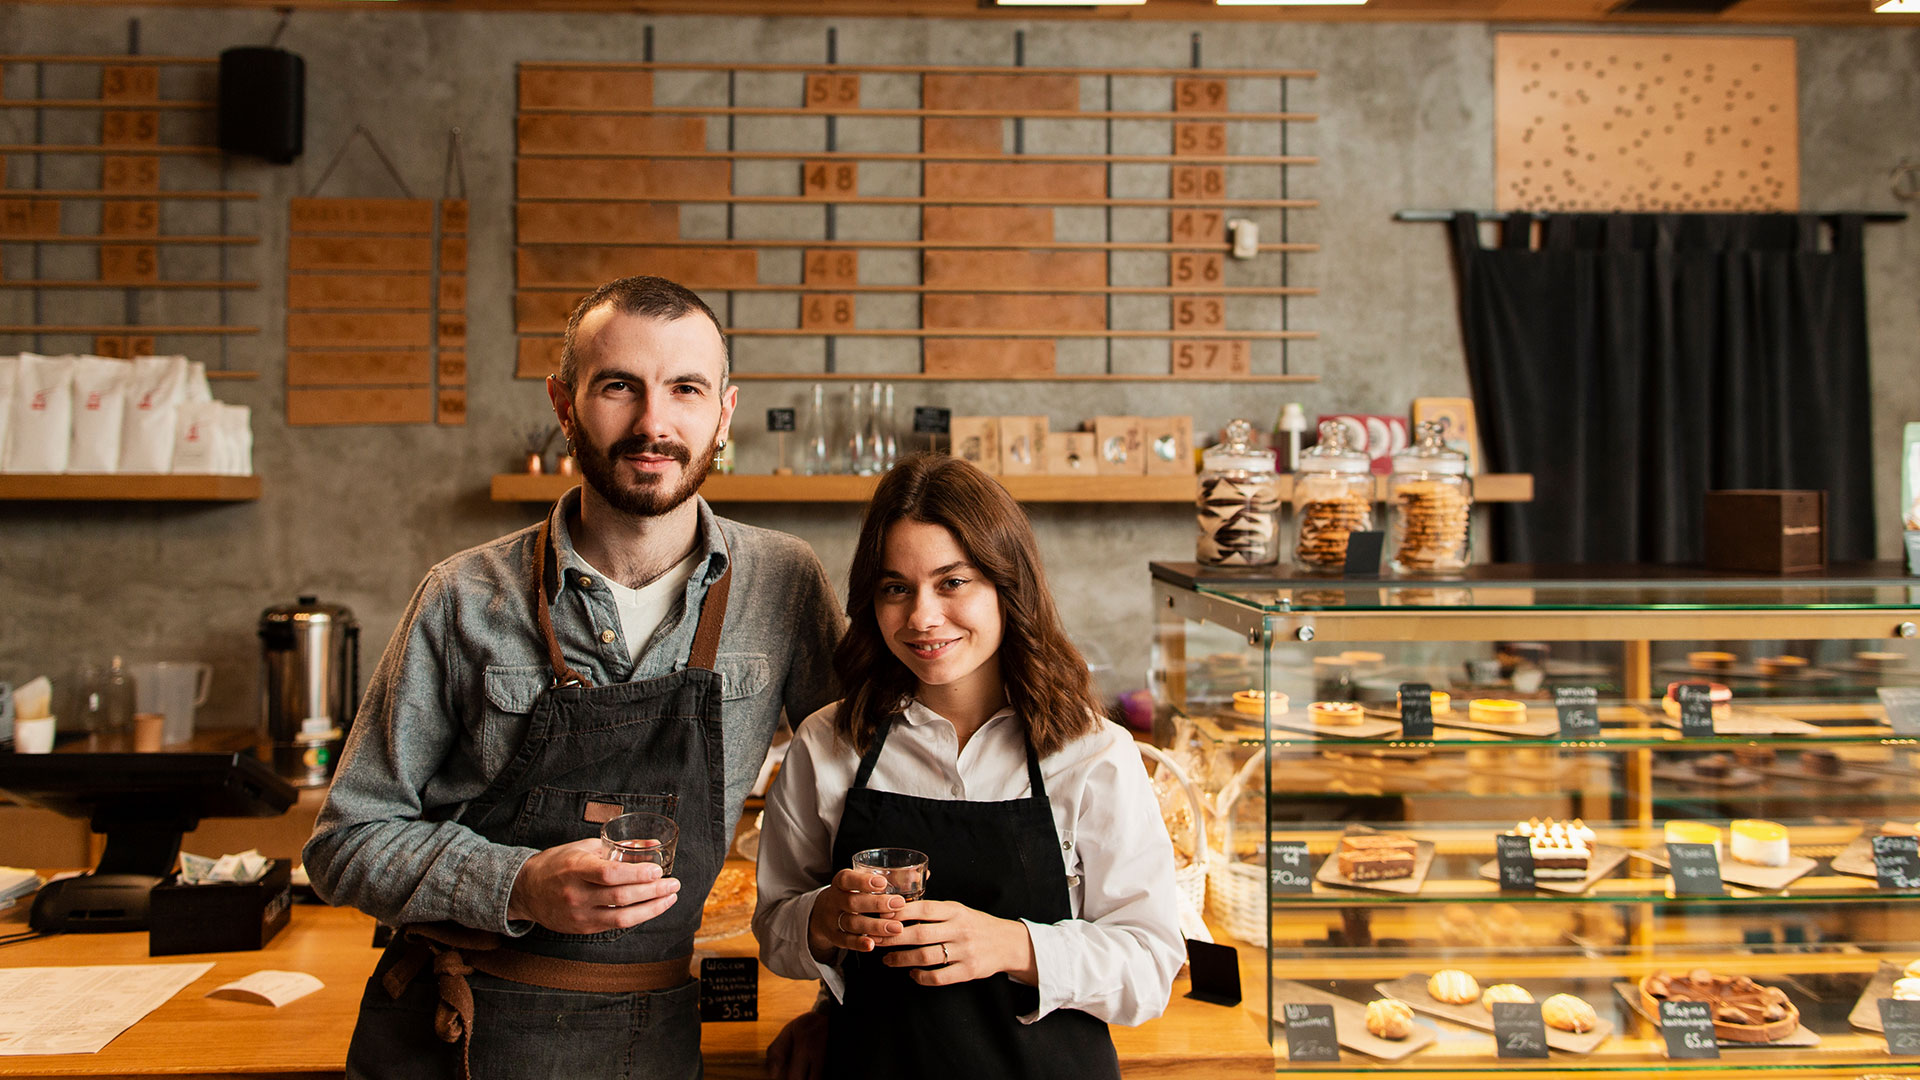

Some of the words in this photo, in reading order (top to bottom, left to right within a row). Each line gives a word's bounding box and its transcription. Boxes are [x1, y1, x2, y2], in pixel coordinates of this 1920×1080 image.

[812, 77, 854, 103] 55
[1181, 84, 1222, 107] 59
[1181, 126, 1222, 149] 55
[809, 165, 853, 191] 48
[1178, 170, 1221, 194] 58
[1178, 213, 1218, 238] 47
[1178, 257, 1219, 281] 56
[809, 298, 851, 324] 68
[1179, 301, 1221, 325] 53
[1178, 344, 1219, 369] 57
